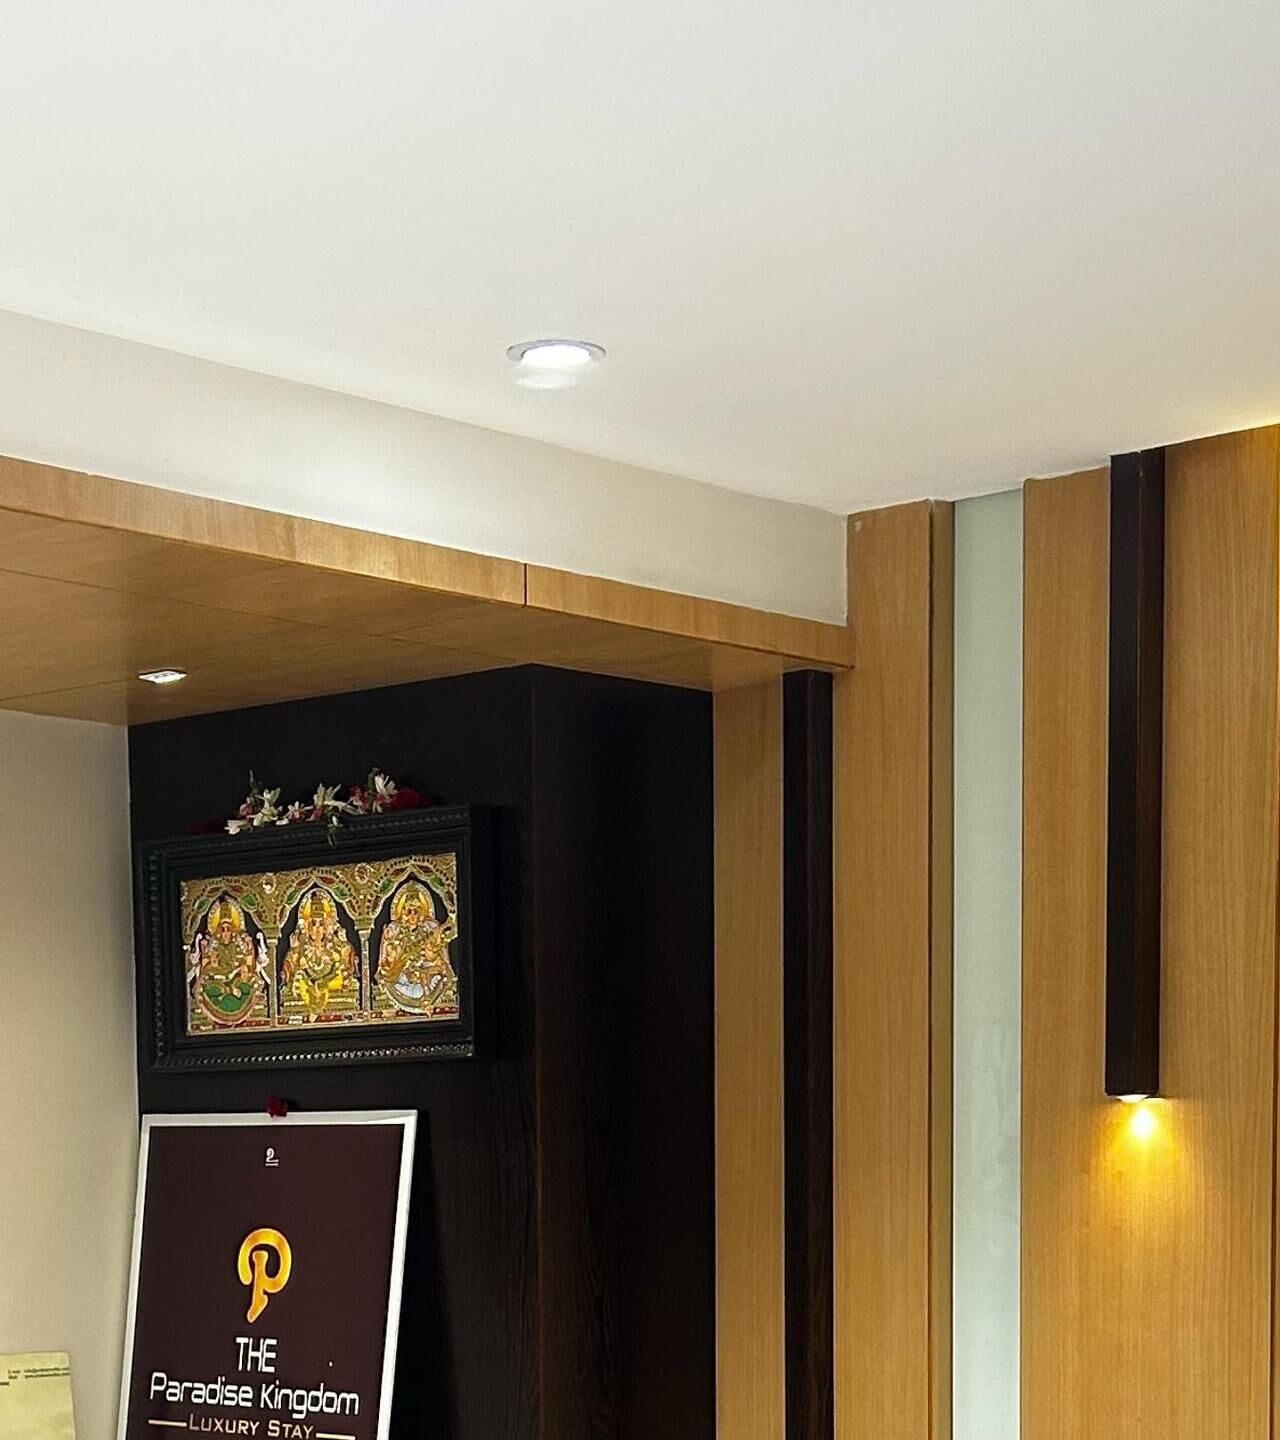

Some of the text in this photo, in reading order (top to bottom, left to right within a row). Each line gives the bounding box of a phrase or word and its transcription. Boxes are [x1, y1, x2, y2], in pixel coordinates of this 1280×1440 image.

[235, 1336, 277, 1373] THE
[150, 1371, 360, 1420] Paradise Kingdom
[189, 1413, 314, 1440] LUXURY STAY
